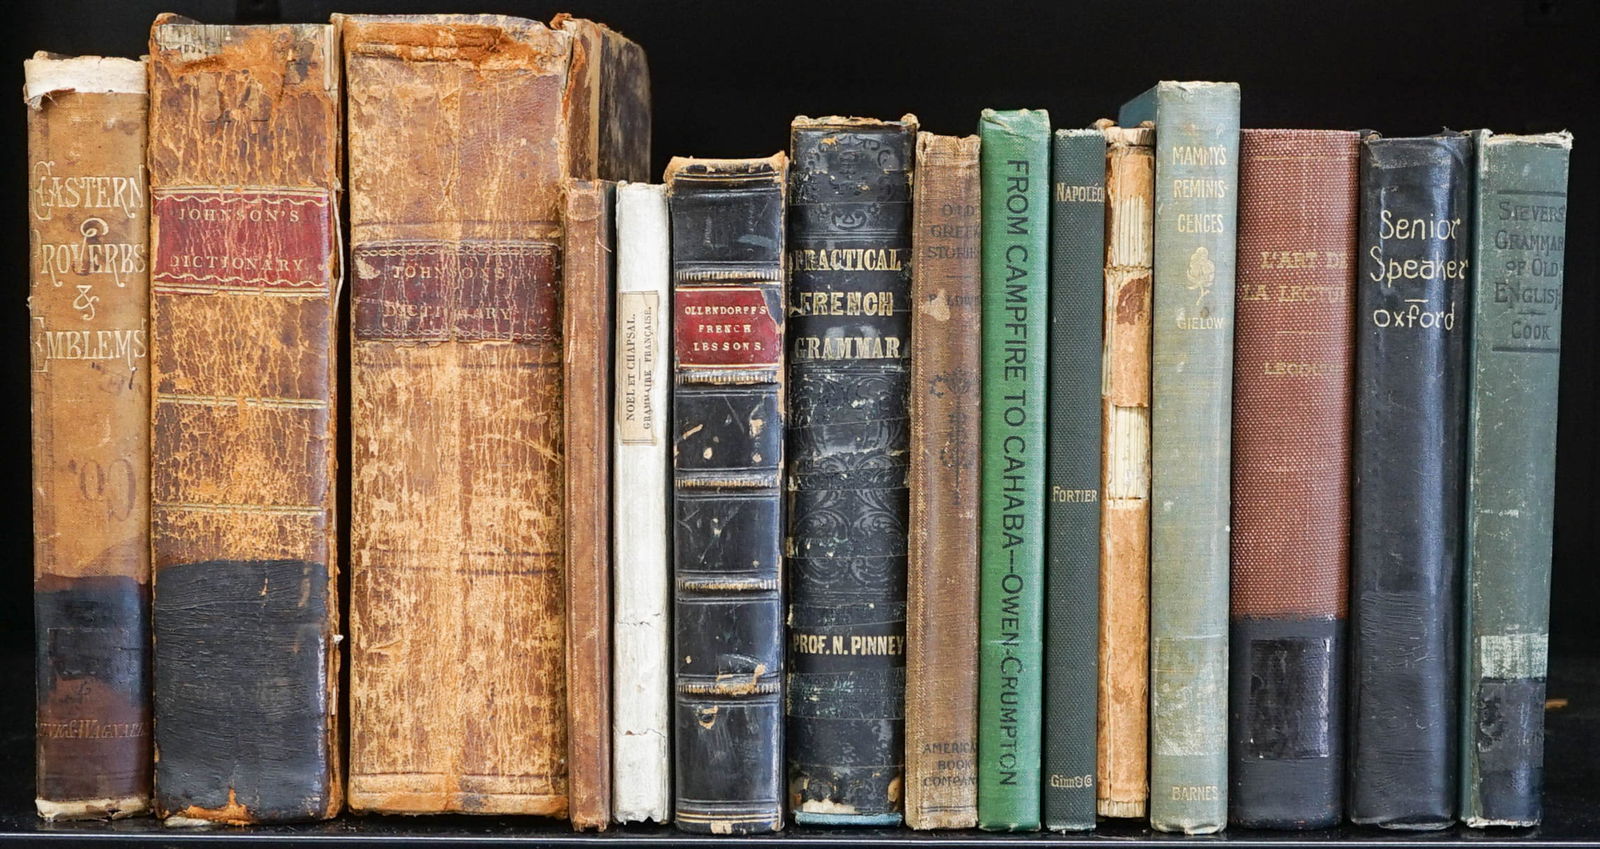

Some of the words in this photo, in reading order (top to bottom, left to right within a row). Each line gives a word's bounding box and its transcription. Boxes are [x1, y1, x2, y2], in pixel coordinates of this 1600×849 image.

[1172, 144, 1227, 166] MAMMY'S
[33, 161, 145, 219] EASTERN
[1006, 160, 1029, 235] FROM
[1056, 182, 1105, 202] NAPOLÉO
[179, 208, 300, 223] JOHNSON'S
[1177, 213, 1224, 234] CENCES
[1379, 210, 1461, 240] Senior
[795, 249, 902, 271] PRACTICAL
[1369, 245, 1469, 288] Speaker
[1531, 258, 1559, 277] OLD
[72, 285, 100, 320] &
[800, 291, 893, 316] FRENCH
[1004, 245, 1028, 381] CAMPFIRE
[699, 324, 752, 333] FRENCH
[1176, 317, 1224, 330] GIELOW
[1511, 320, 1551, 340] COOK
[626, 313, 635, 370] CHAPSAL.
[693, 342, 766, 352] LESSONS.
[794, 337, 901, 359] GRAMMAR
[627, 373, 635, 386] ET
[626, 389, 635, 421] NOEL
[643, 369, 653, 430] GRAMMAIRE
[1003, 389, 1027, 427] TO
[1052, 486, 1098, 502] FORTIER
[793, 634, 830, 655] PROF.
[832, 635, 849, 655] N.
[851, 635, 904, 656] PINNEY
[923, 742, 977, 754] AMERICA
[923, 775, 977, 787] COMPAN
[1172, 786, 1218, 800] BARNES
